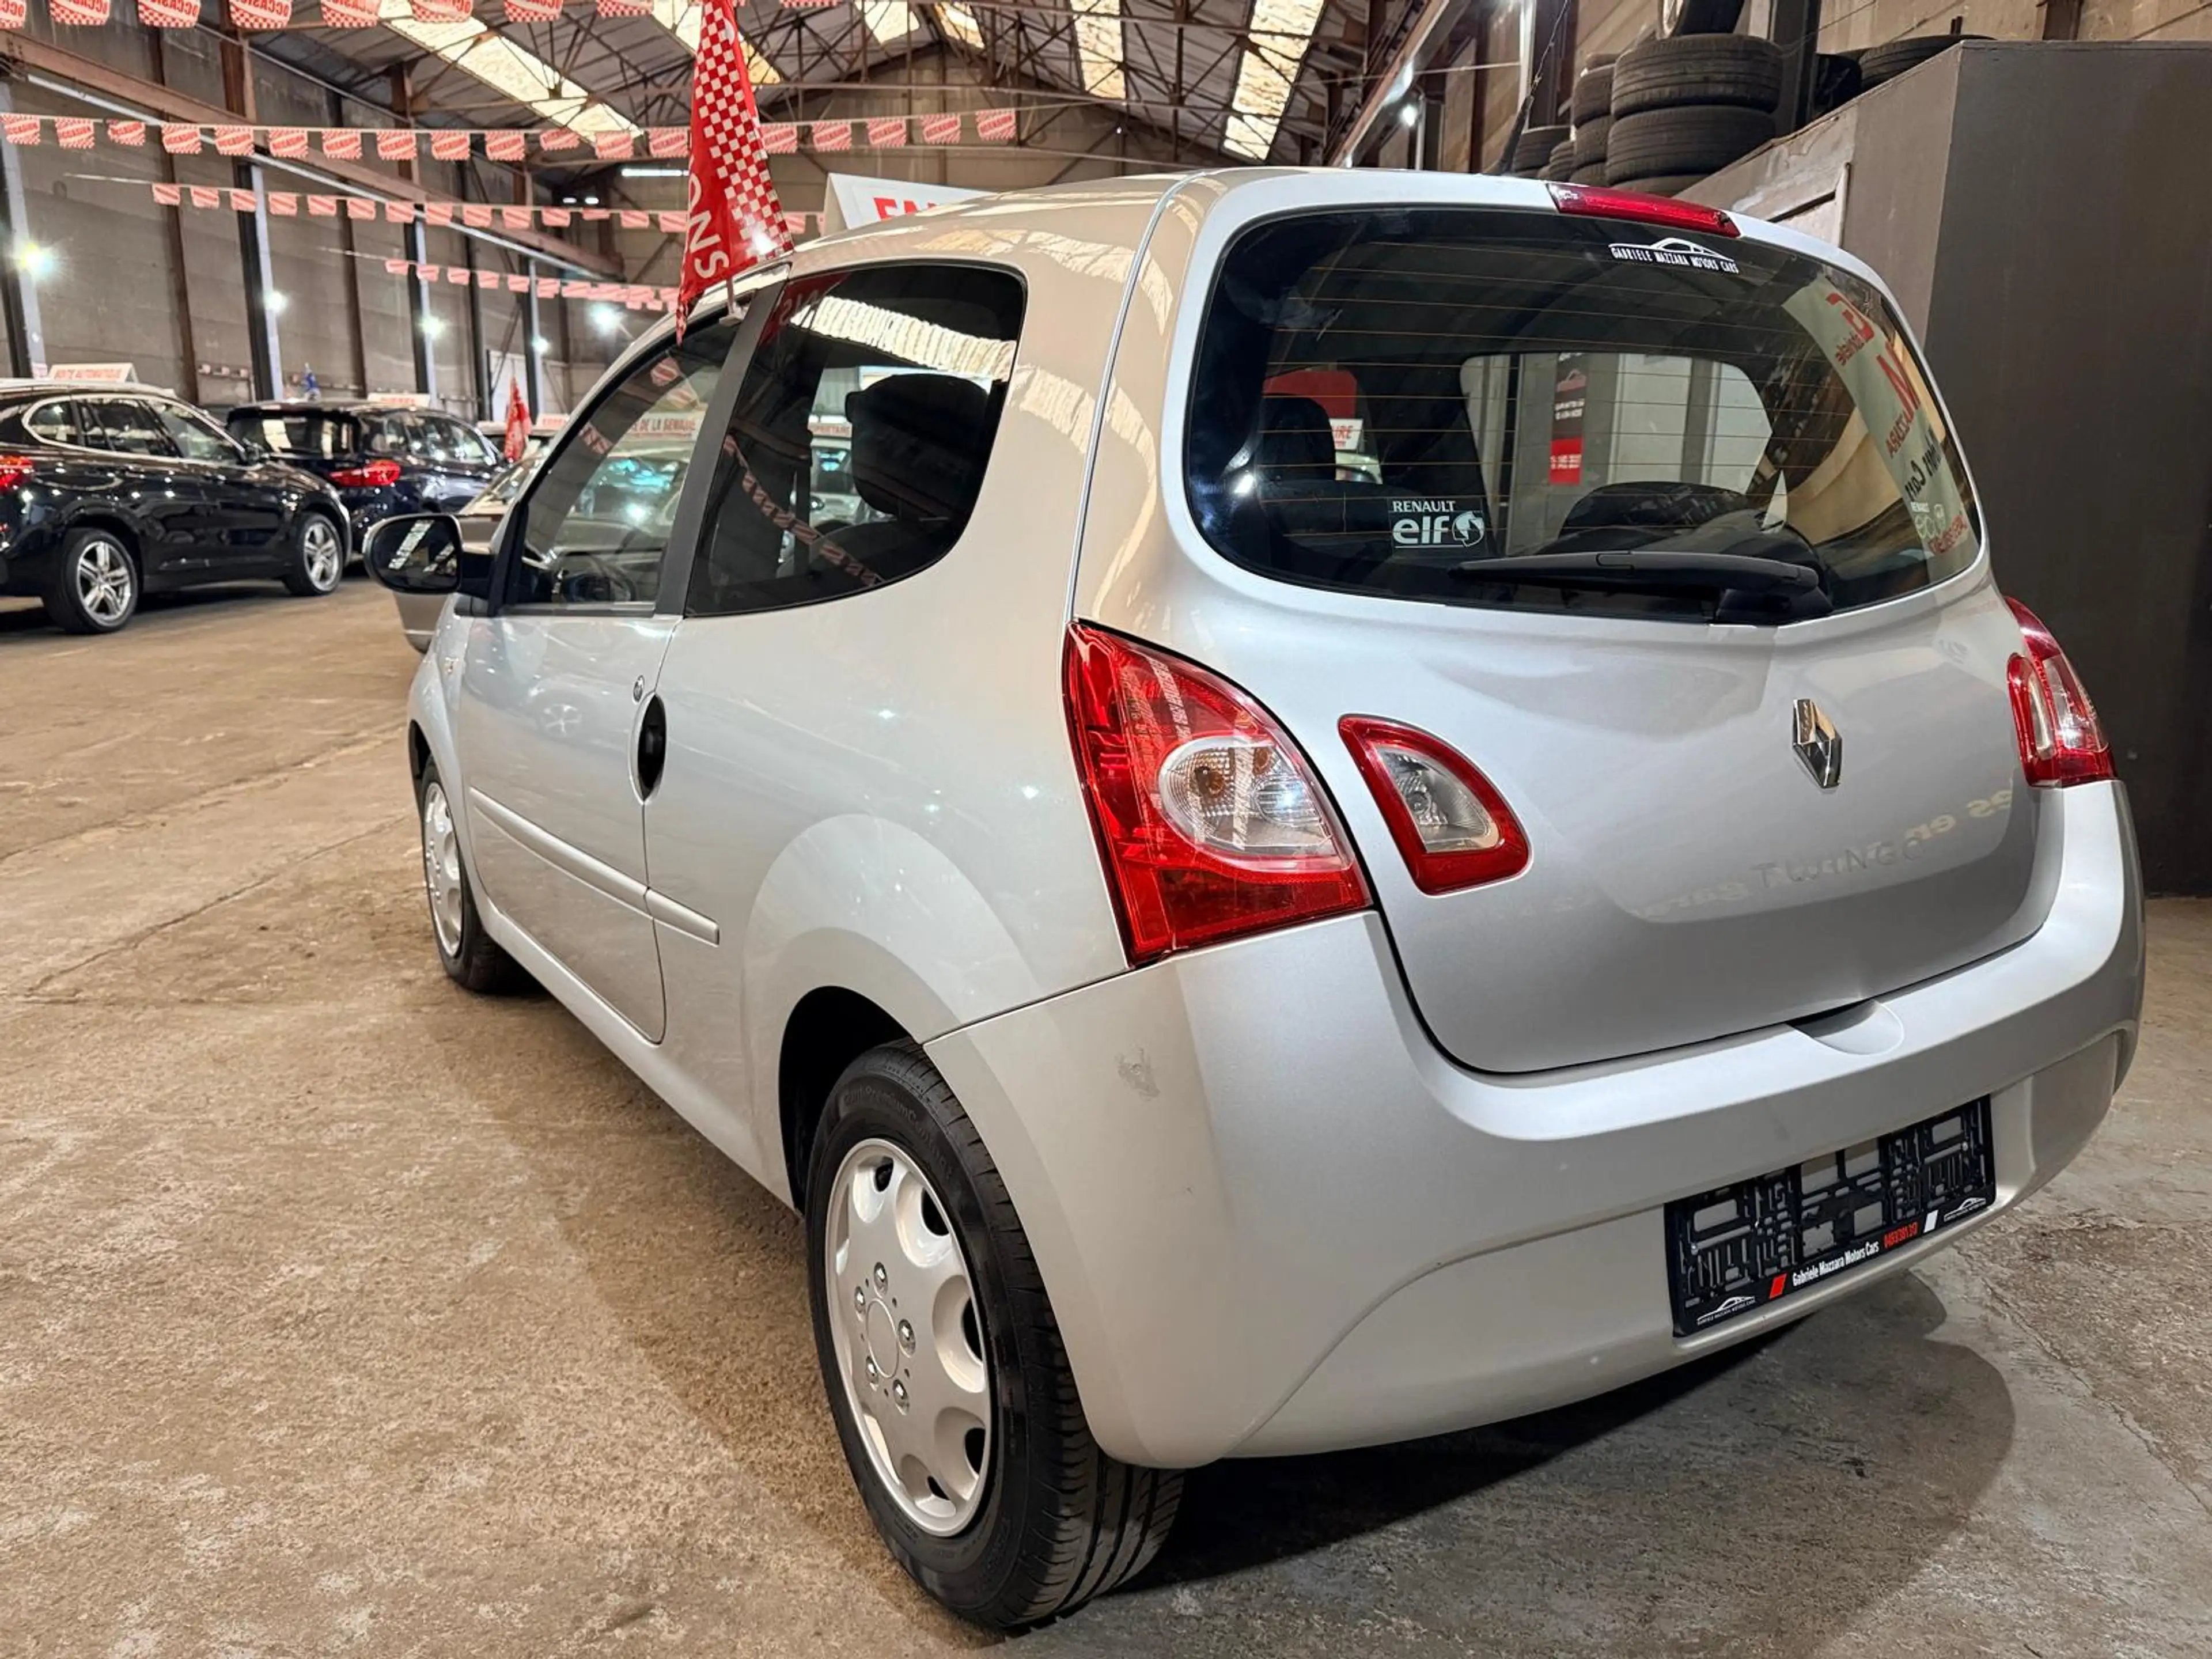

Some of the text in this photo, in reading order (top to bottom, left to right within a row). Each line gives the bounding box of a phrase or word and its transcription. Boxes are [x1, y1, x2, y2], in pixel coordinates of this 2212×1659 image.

[1392, 501, 1456, 512] RENAULT
[1393, 516, 1450, 544] elf
[1865, 1240, 1880, 1256] Cars
